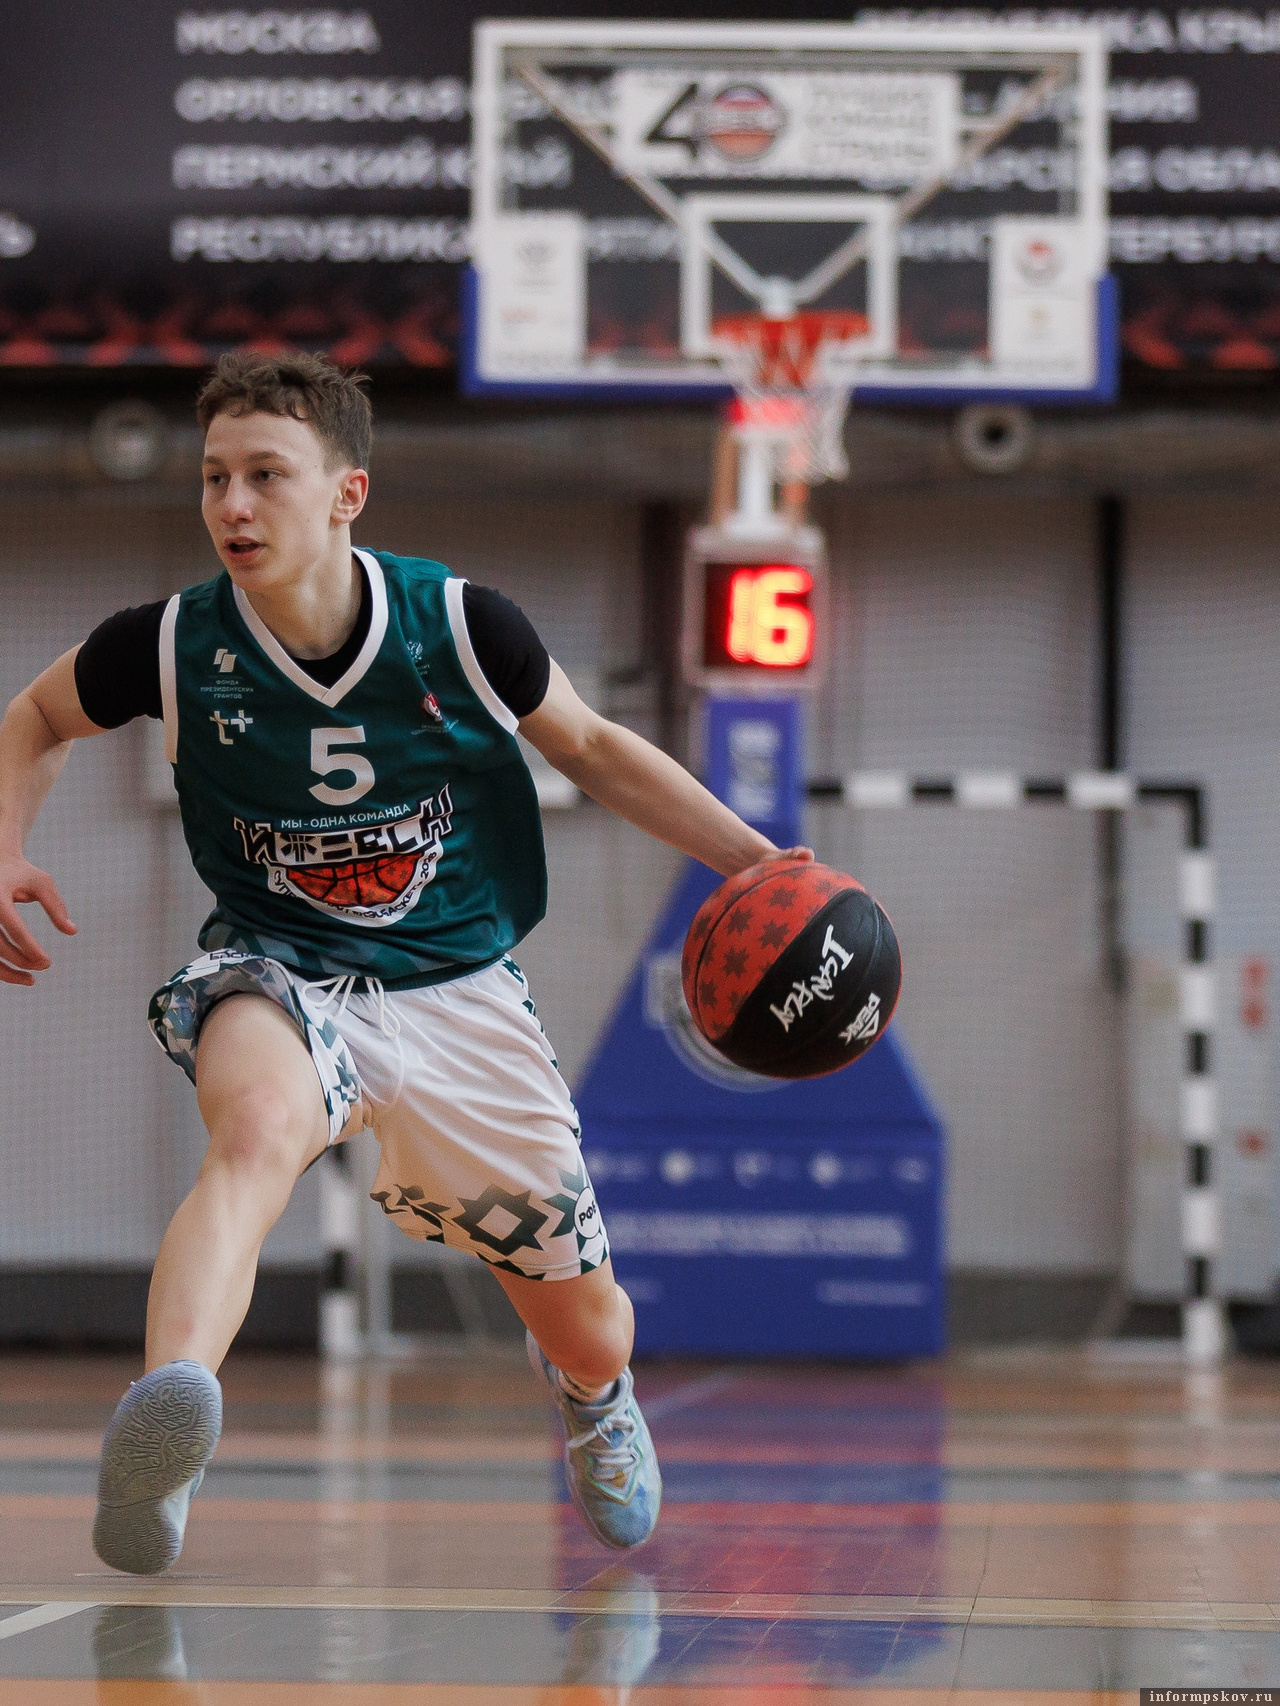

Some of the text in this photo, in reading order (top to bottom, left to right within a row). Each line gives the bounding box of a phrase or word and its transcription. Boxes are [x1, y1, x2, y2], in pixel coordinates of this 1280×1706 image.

[175, 10, 380, 54] МОСКВА
[174, 77, 466, 122] ОРЛОВСКАЯ
[172, 136, 435, 189] ПЕРМСКИЙ
[728, 566, 813, 665] 16
[309, 725, 376, 806] 5
[349, 803, 412, 824] КОМАНДА
